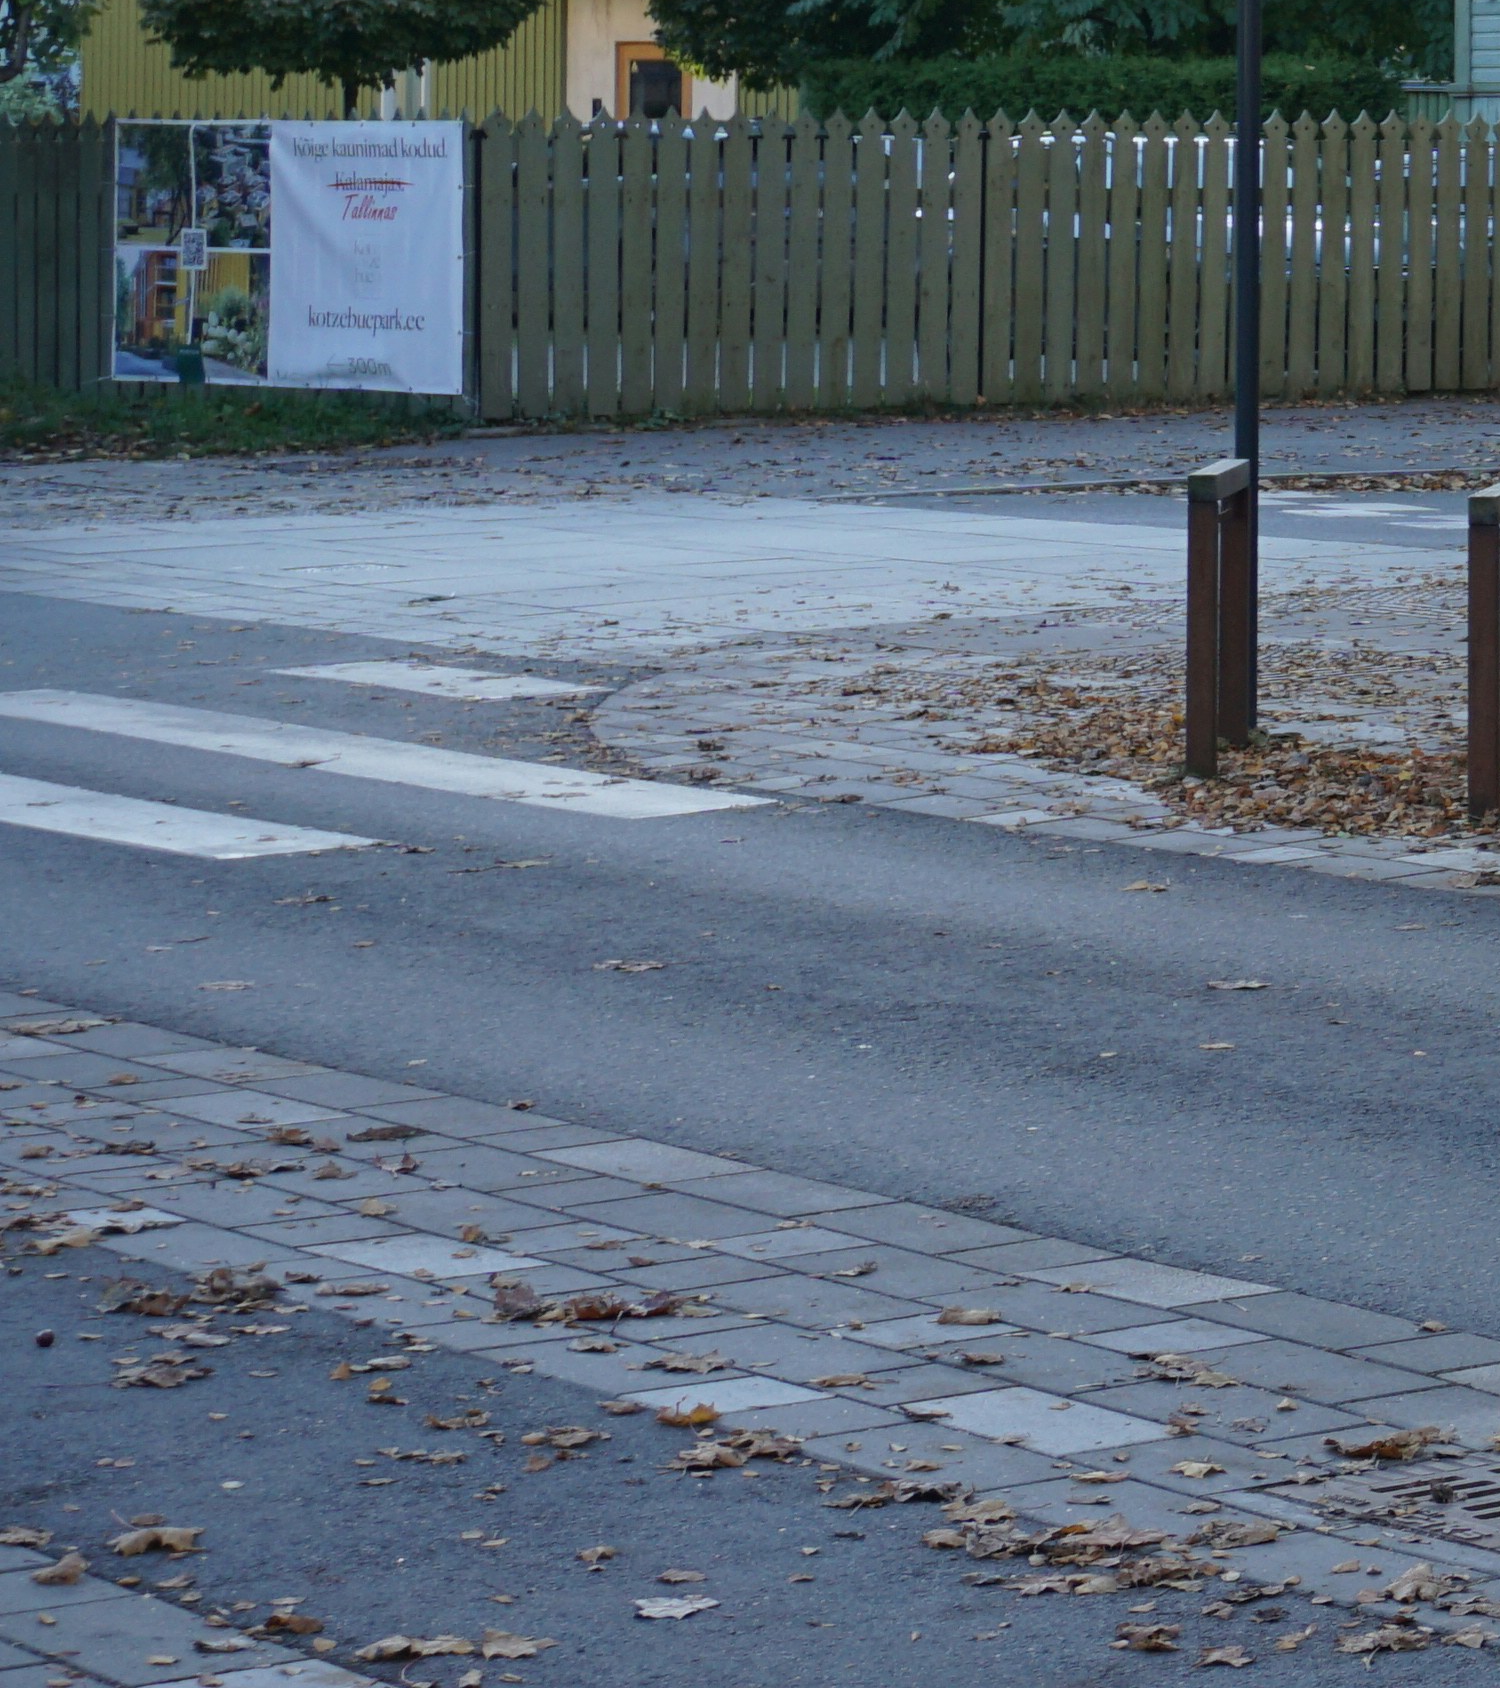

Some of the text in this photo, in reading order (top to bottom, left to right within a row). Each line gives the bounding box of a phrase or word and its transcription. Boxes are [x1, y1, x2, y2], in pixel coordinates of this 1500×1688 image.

[293, 137, 448, 162] Kõige kaunimad kodud.
[342, 194, 398, 221] Tallinnas
[308, 304, 425, 336] kotzebuepark.ee
[347, 357, 392, 376] 300m
